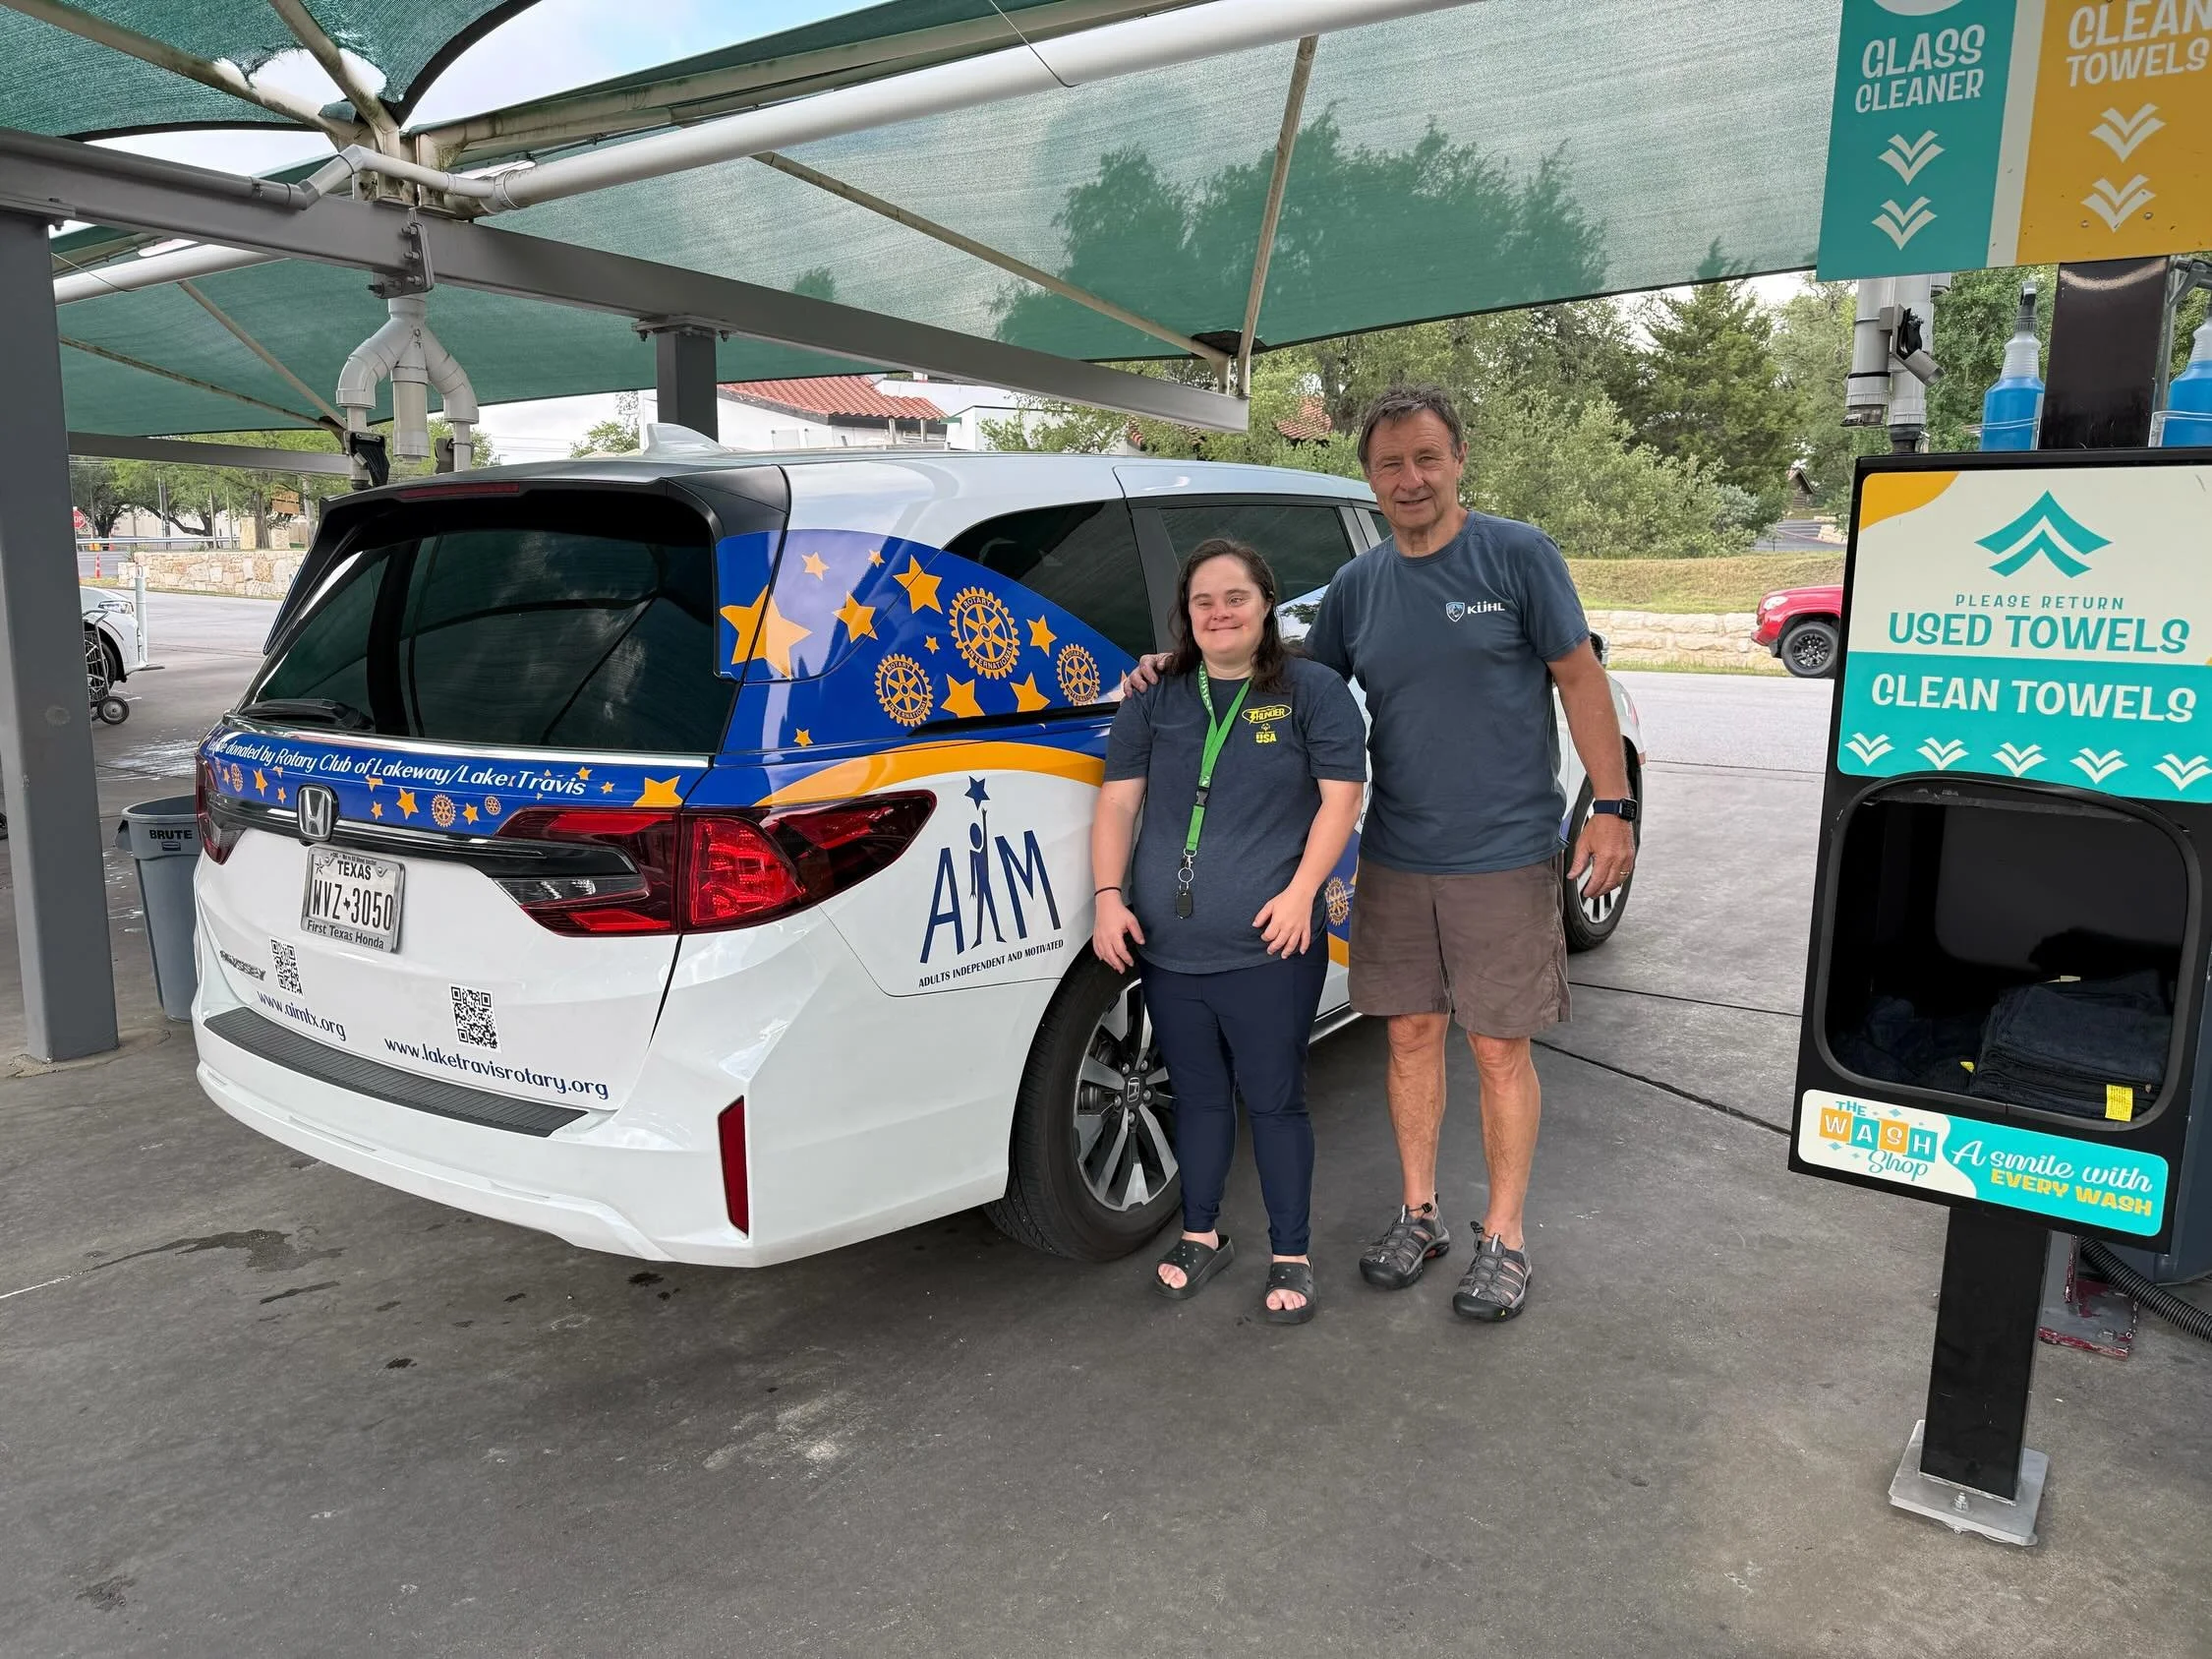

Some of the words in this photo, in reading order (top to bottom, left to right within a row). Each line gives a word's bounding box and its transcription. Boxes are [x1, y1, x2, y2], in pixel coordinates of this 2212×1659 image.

[2068, 0, 2212, 49] CLEAN
[1862, 24, 1985, 79] GLASS
[2066, 37, 2210, 87] TOWELS
[1854, 68, 1984, 113] CLEANER
[963, 597, 992, 609] ROTARY
[1467, 601, 1505, 614] KÜHL
[1955, 594, 2030, 608] PLEASE
[2041, 596, 2125, 610] RETURN
[1889, 612, 1992, 647] USED
[2006, 615, 2190, 654] TOWELS
[887, 661, 910, 672] ROTARY
[967, 644, 1014, 670] INTERNATIONAL
[889, 699, 927, 719] INTERNATIONAL
[1872, 673, 2000, 712] CLEAN
[2011, 680, 2197, 724] TOWELS
[1255, 733, 1277, 743] USA
[226, 740, 258, 760] donated
[260, 745, 276, 767] by
[275, 748, 318, 773] Rotary
[320, 753, 352, 773] Club
[355, 757, 376, 775] of
[373, 759, 508, 787] Lakeway/Lake
[516, 771, 587, 795] Travis
[149, 830, 193, 840] BRUTE
[337, 860, 372, 880] TEXAS
[307, 919, 326, 934] First
[329, 925, 353, 941] Texas
[355, 932, 384, 949] Honda
[918, 972, 951, 988] ADULTS
[953, 955, 1006, 978] INDEPENDENT
[1007, 951, 1023, 963] AND
[1024, 939, 1064, 957] MOTIVATED
[257, 990, 346, 1042] www.aimtx.org
[384, 1037, 609, 1100] www.laketravisrotary.org
[1835, 1100, 1867, 1117] THE
[1824, 1114, 1932, 1157] WASH
[1868, 1150, 1929, 1182] Shop
[1950, 1140, 1987, 1166] A
[1990, 1150, 2074, 1179] smile
[2082, 1165, 2153, 1193] with
[1991, 1168, 2069, 1198] EVERY
[2075, 1185, 2152, 1216] WASH
